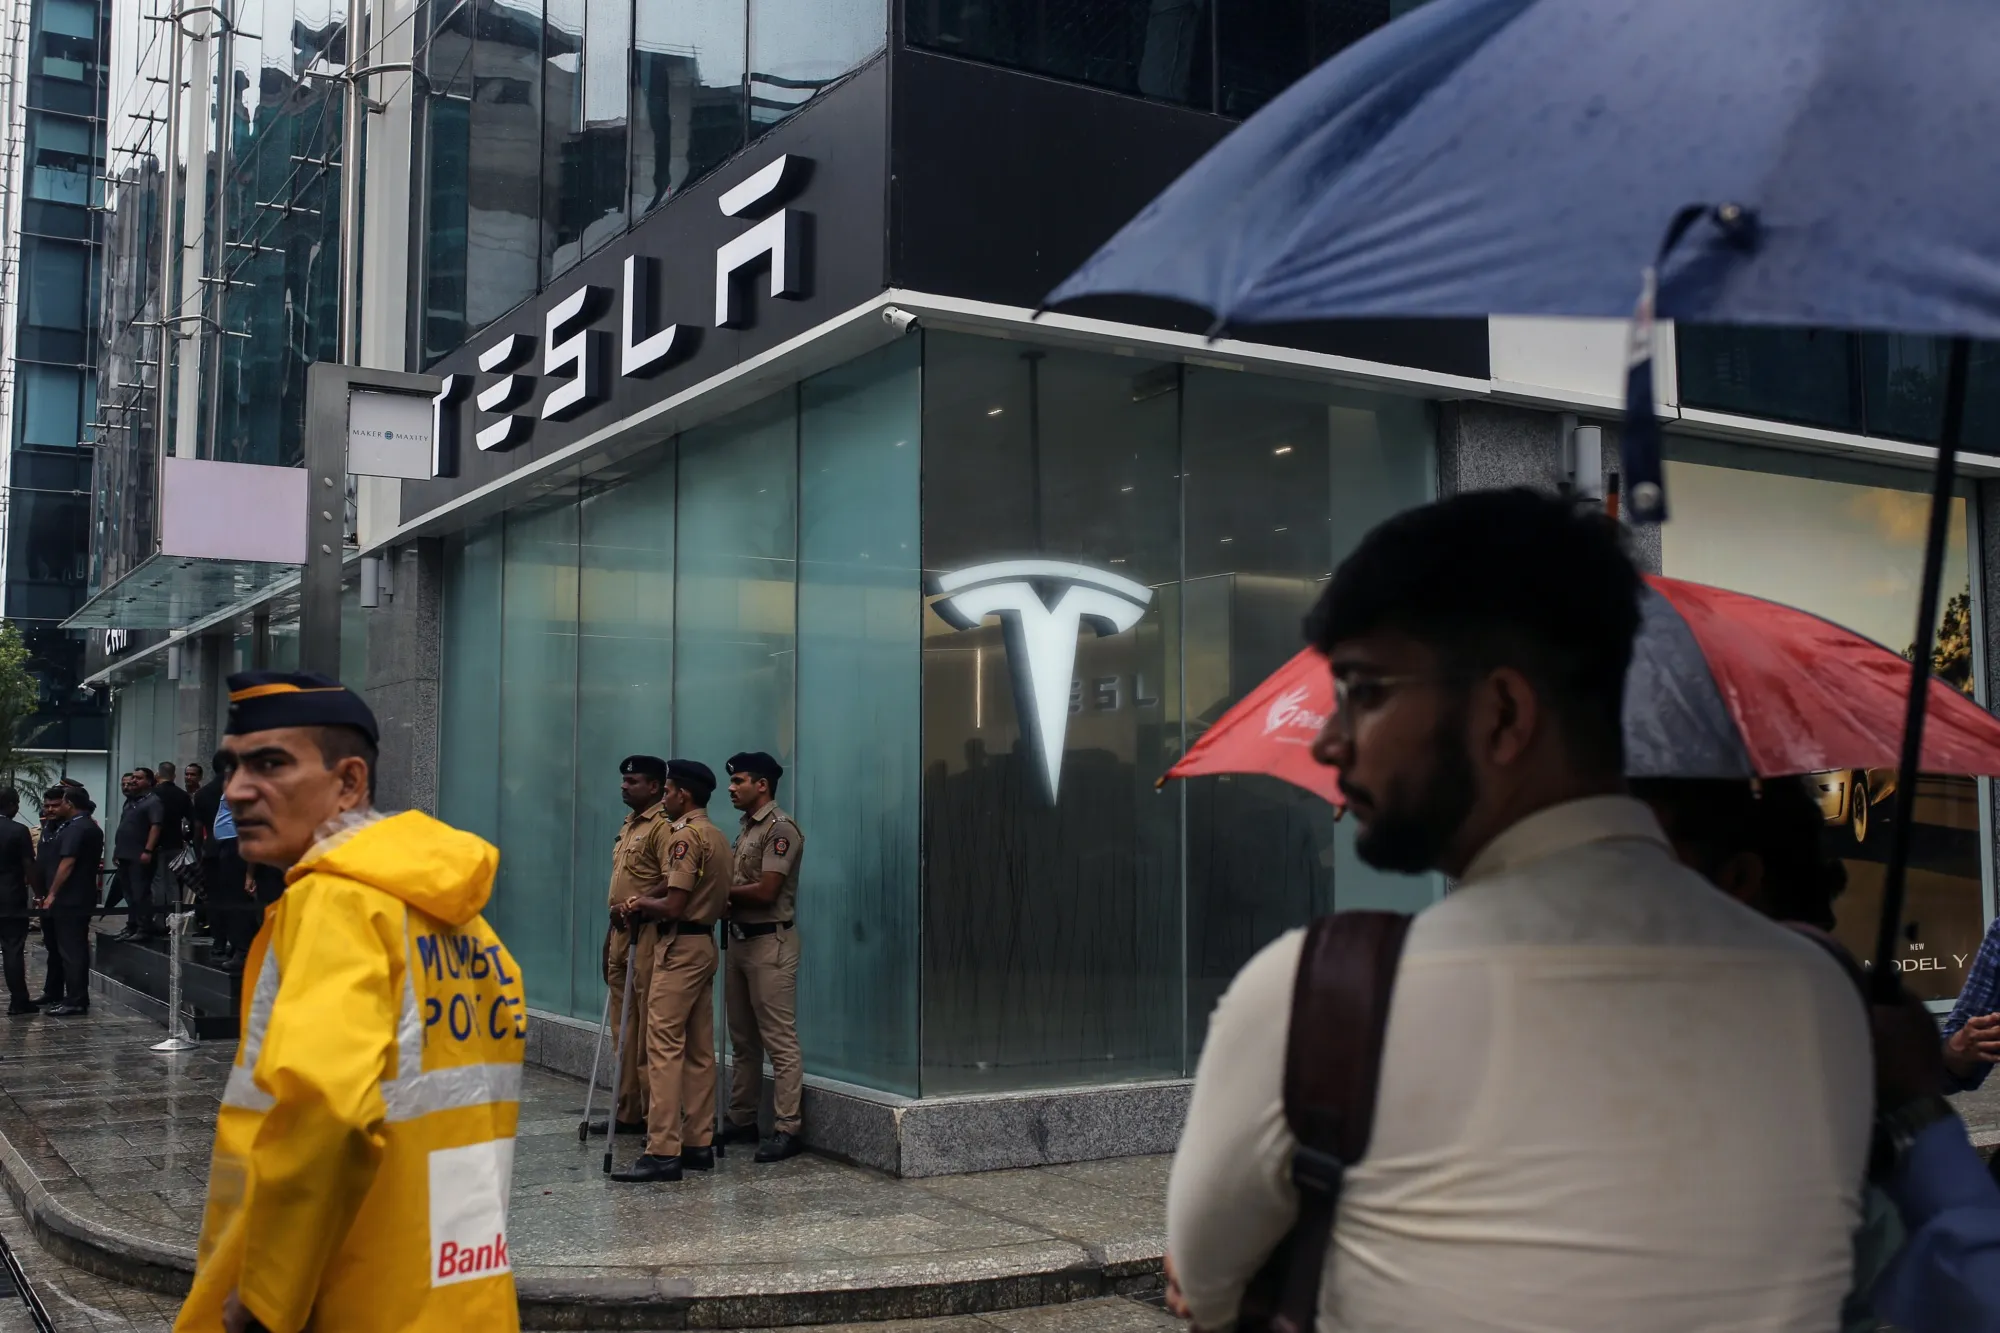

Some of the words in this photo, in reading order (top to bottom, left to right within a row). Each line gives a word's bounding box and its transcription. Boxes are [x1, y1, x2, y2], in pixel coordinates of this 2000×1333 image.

[352, 429, 383, 438] MAKER
[395, 433, 429, 442] MAXITY
[416, 933, 514, 986] MUMBI
[1909, 943, 1925, 951] NEW
[1952, 953, 1968, 969] Y
[424, 993, 527, 1043] POCE
[437, 1232, 509, 1279] Bank
